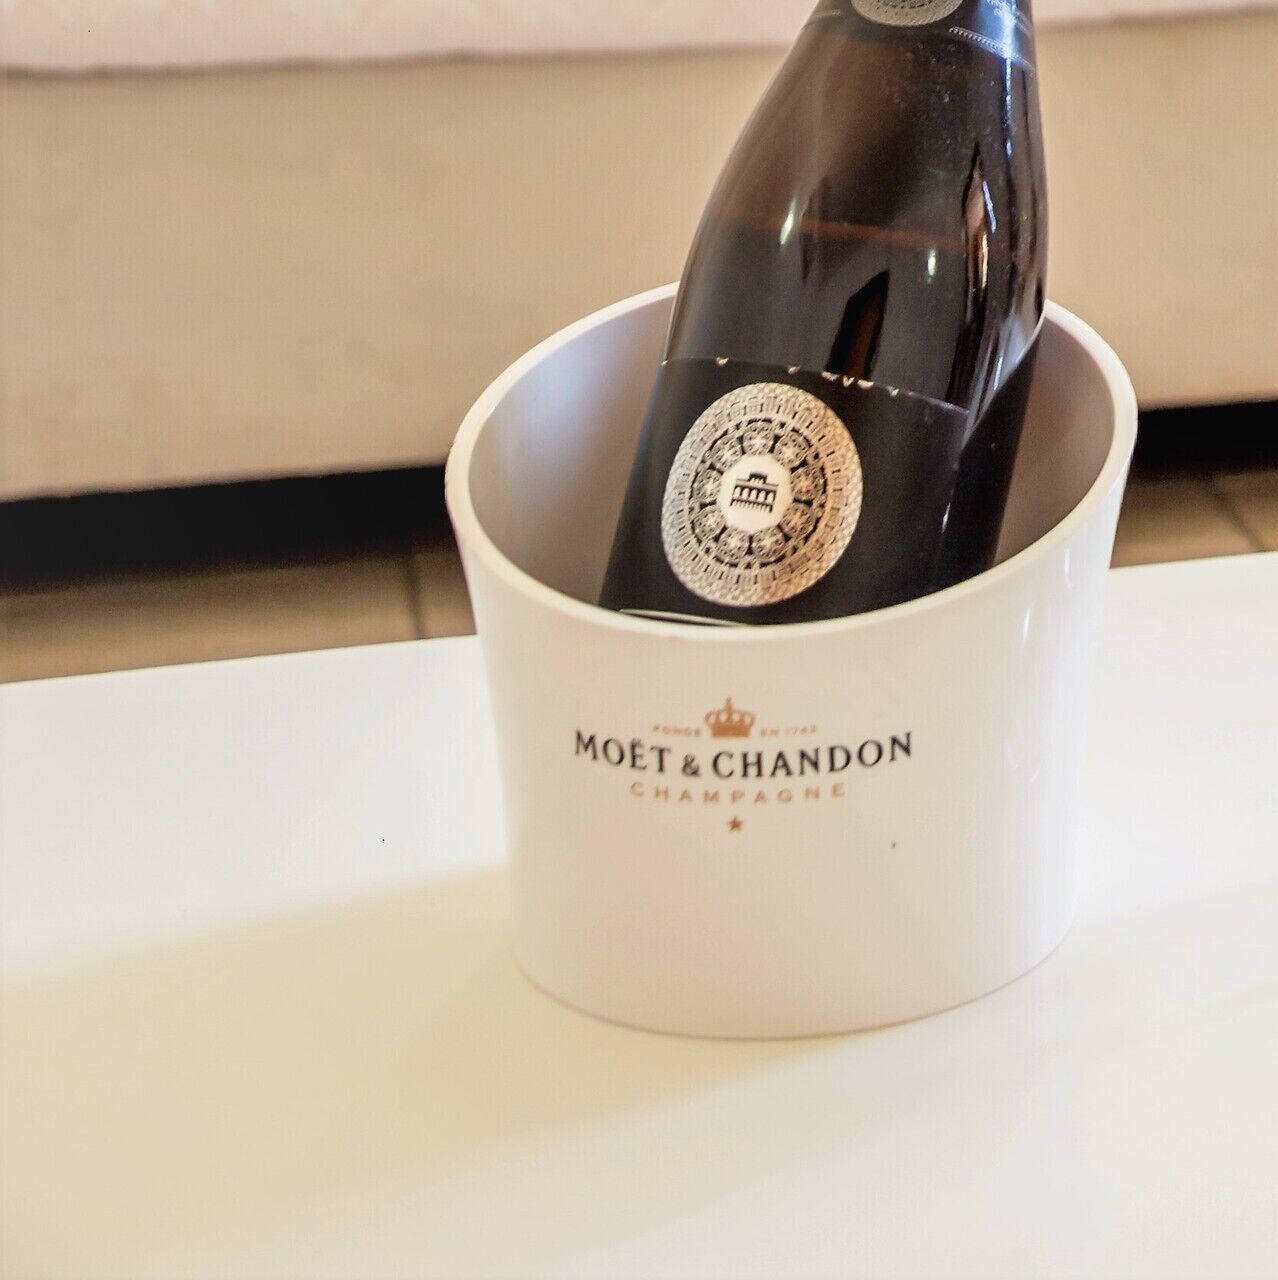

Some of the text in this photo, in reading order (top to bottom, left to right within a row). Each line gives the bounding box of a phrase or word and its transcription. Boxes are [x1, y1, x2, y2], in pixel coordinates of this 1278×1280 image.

[575, 728, 914, 779] MOËT & CHANDON
[629, 781, 846, 804] CHAMPAGNE
